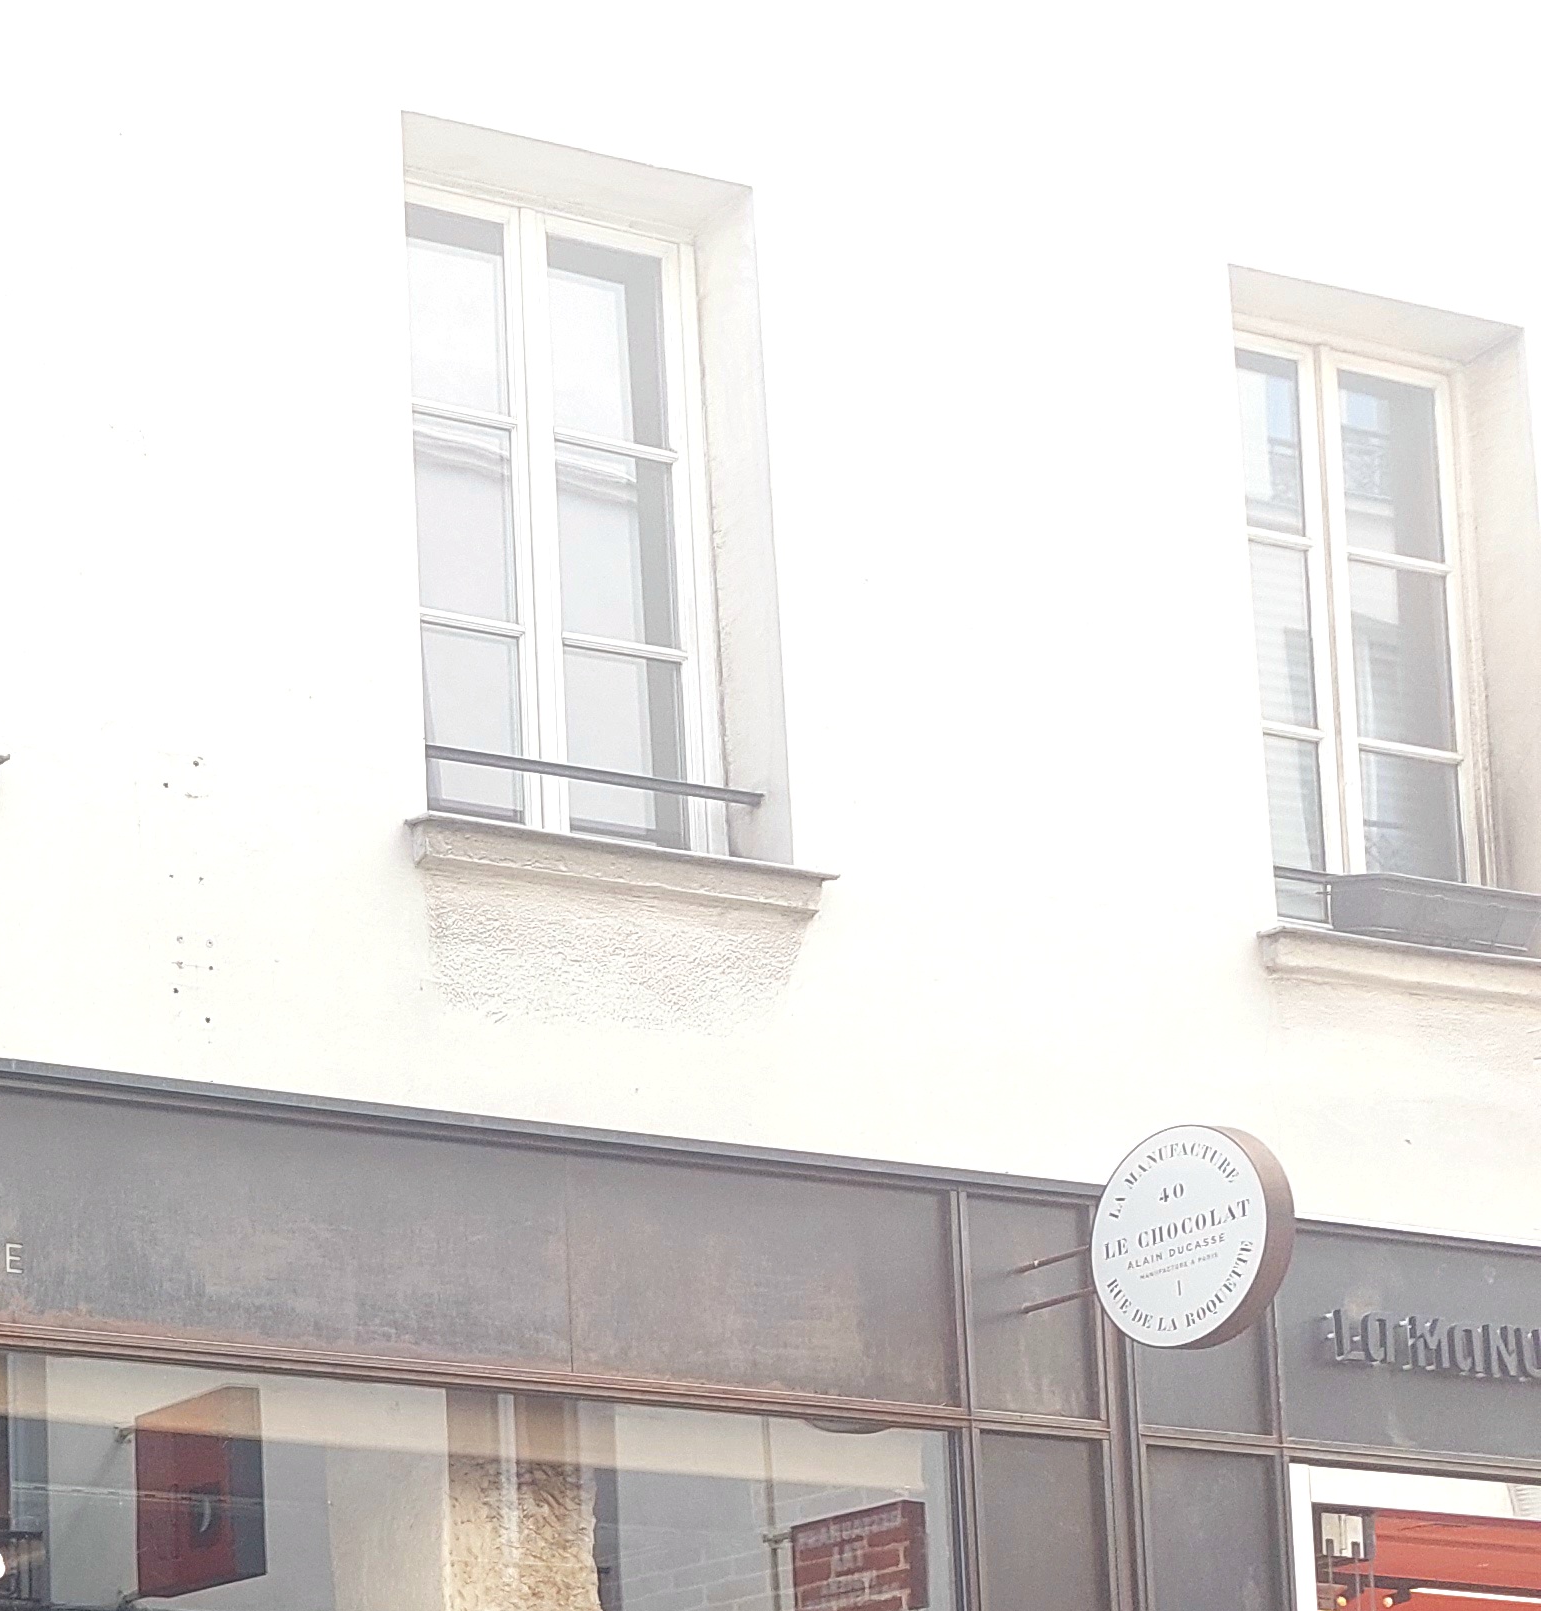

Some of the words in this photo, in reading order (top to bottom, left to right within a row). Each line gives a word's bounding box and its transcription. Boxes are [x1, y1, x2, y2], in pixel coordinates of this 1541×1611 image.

[1123, 1141, 1240, 1190] MANUFACTURE
[1159, 1182, 1185, 1203] 40
[1103, 1237, 1129, 1261] LE
[1137, 1198, 1250, 1249] CHOCOLAT
[1127, 1252, 1163, 1271] ALAIN
[1168, 1232, 1226, 1258] DUCASSE
[1106, 1278, 1132, 1315] RUE
[1131, 1308, 1154, 1329] DE
[1157, 1317, 1178, 1332] LA
[1185, 1240, 1254, 1328] ROQUETTE
